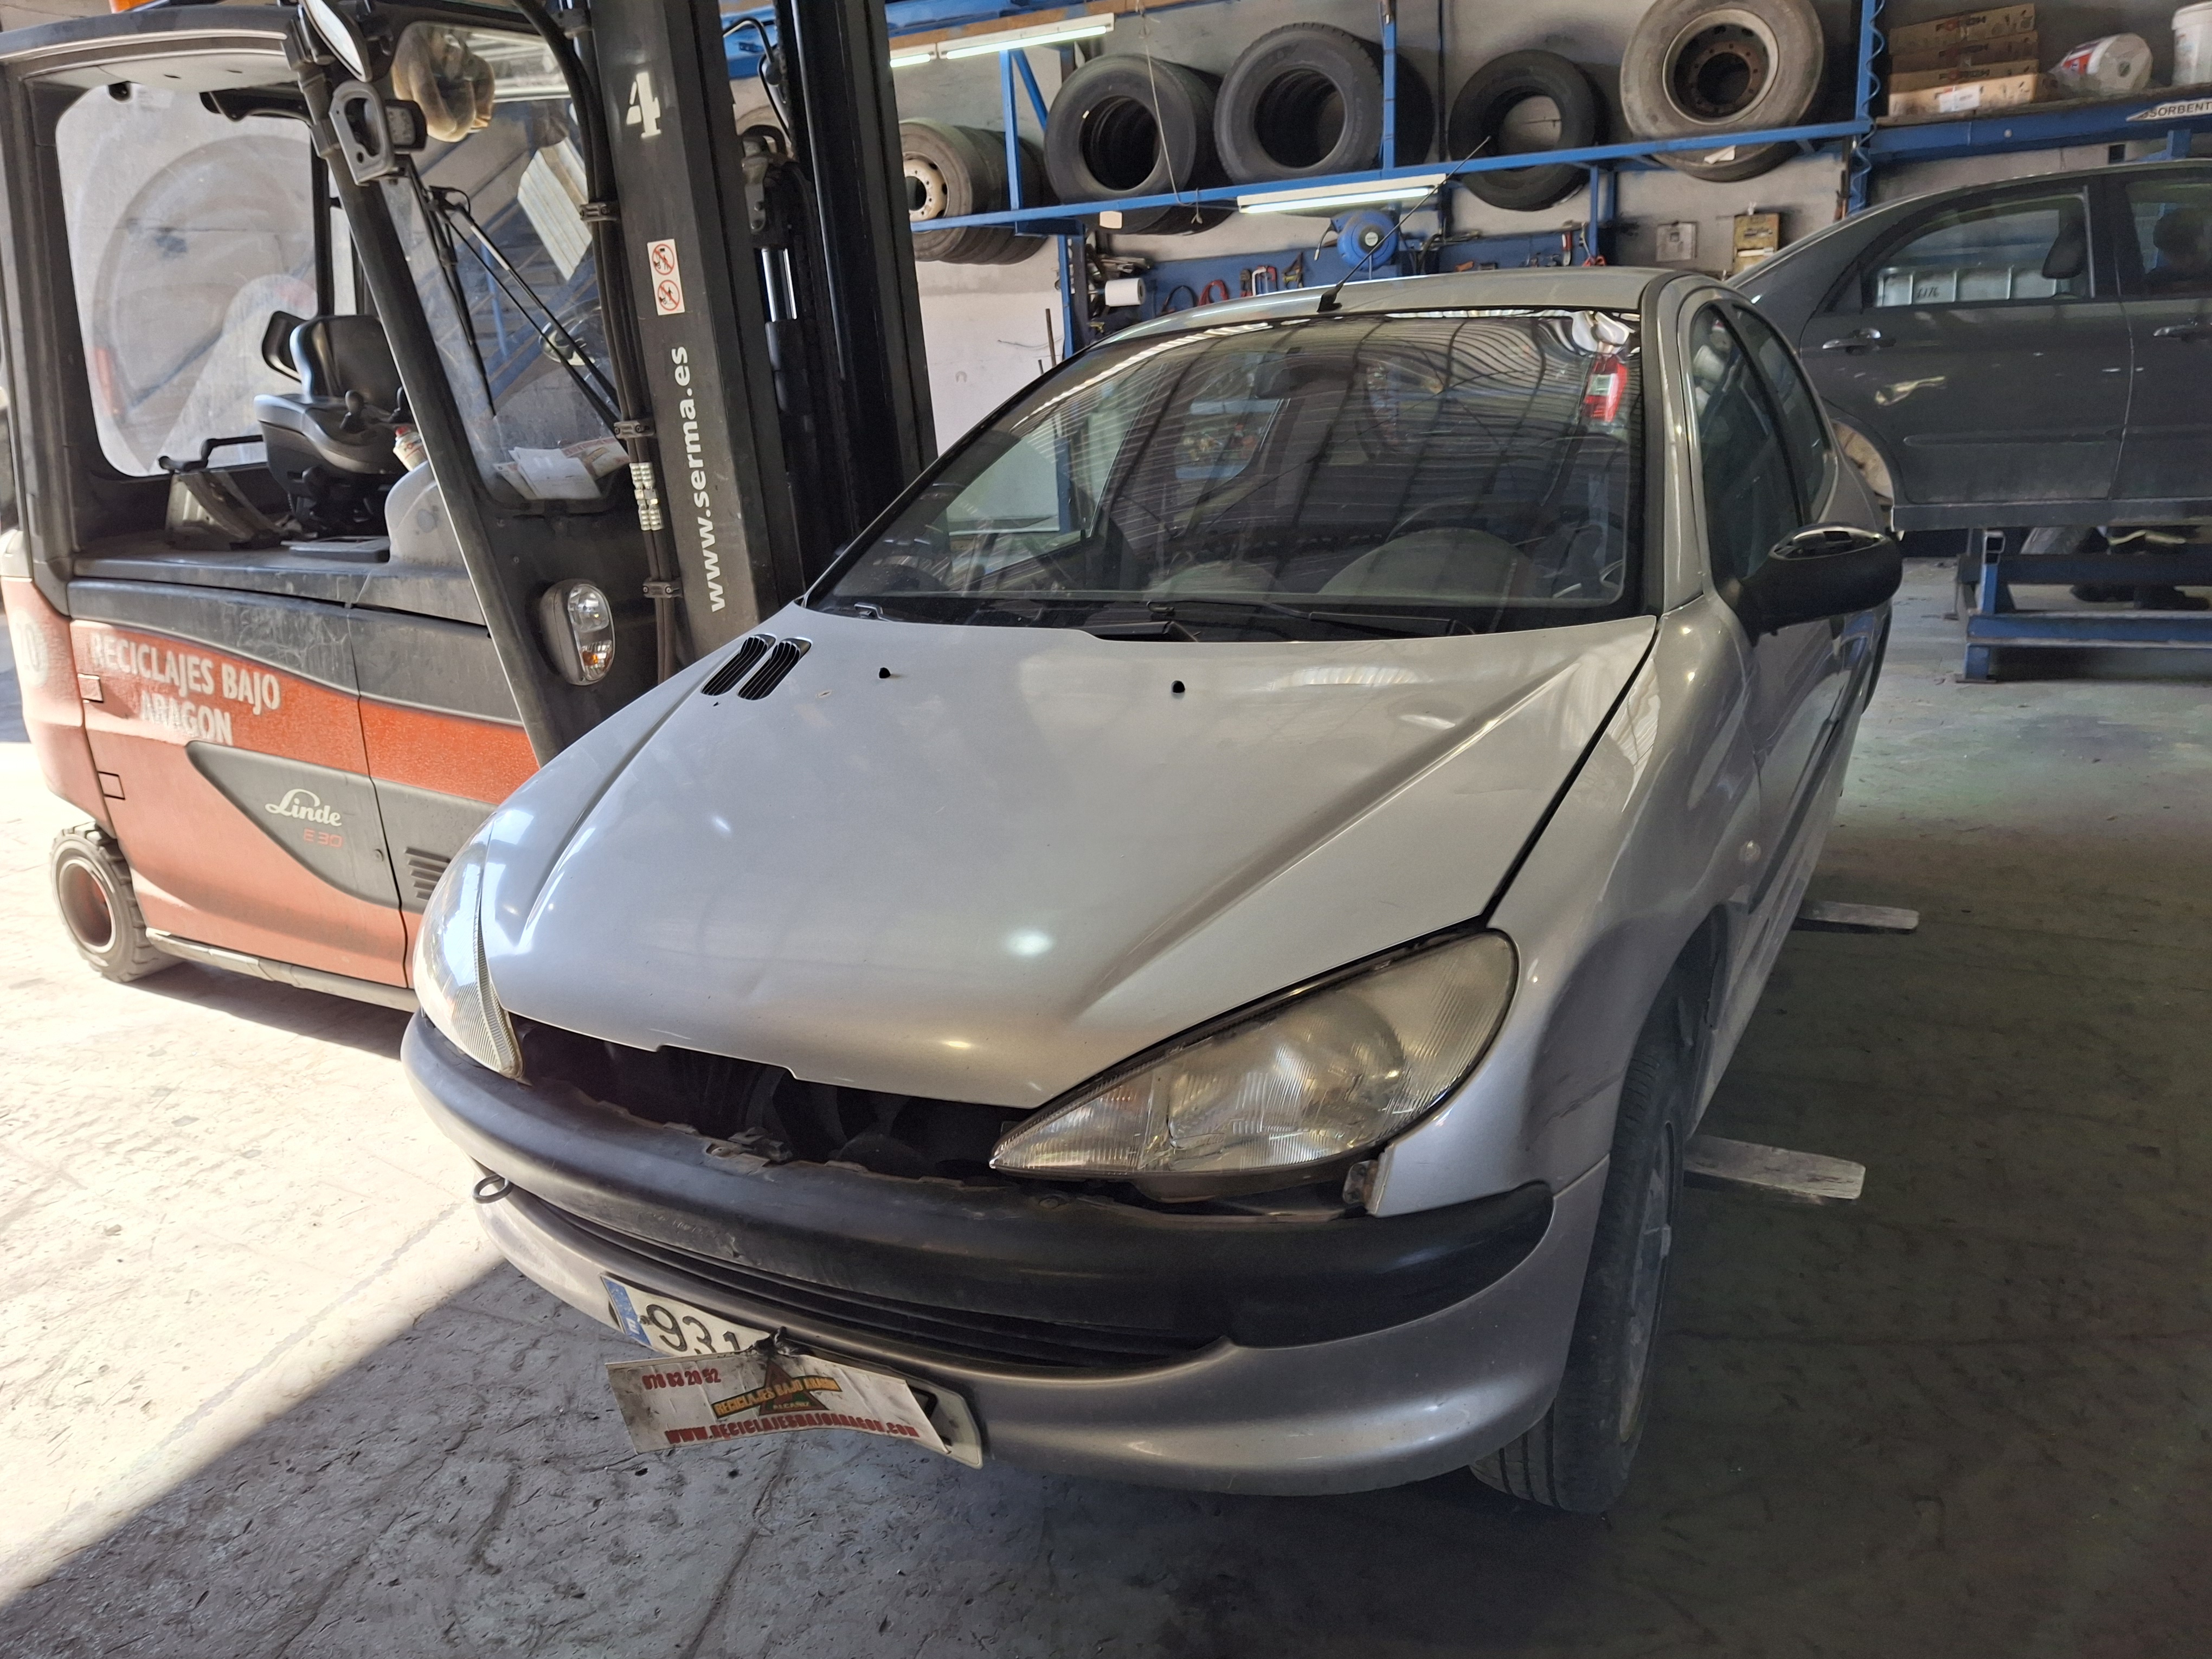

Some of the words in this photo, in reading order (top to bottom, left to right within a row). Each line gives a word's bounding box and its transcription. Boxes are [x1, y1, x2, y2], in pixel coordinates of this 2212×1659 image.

[626, 71, 661, 138] 4
[671, 346, 726, 613] www.serma.es
[89, 632, 215, 698] RECICLAJES
[221, 663, 281, 716] BAJO
[139, 690, 234, 746] ARAGON
[265, 788, 343, 827] Linde
[304, 827, 316, 843] E
[317, 831, 344, 848] 30
[625, 1317, 640, 1335] E
